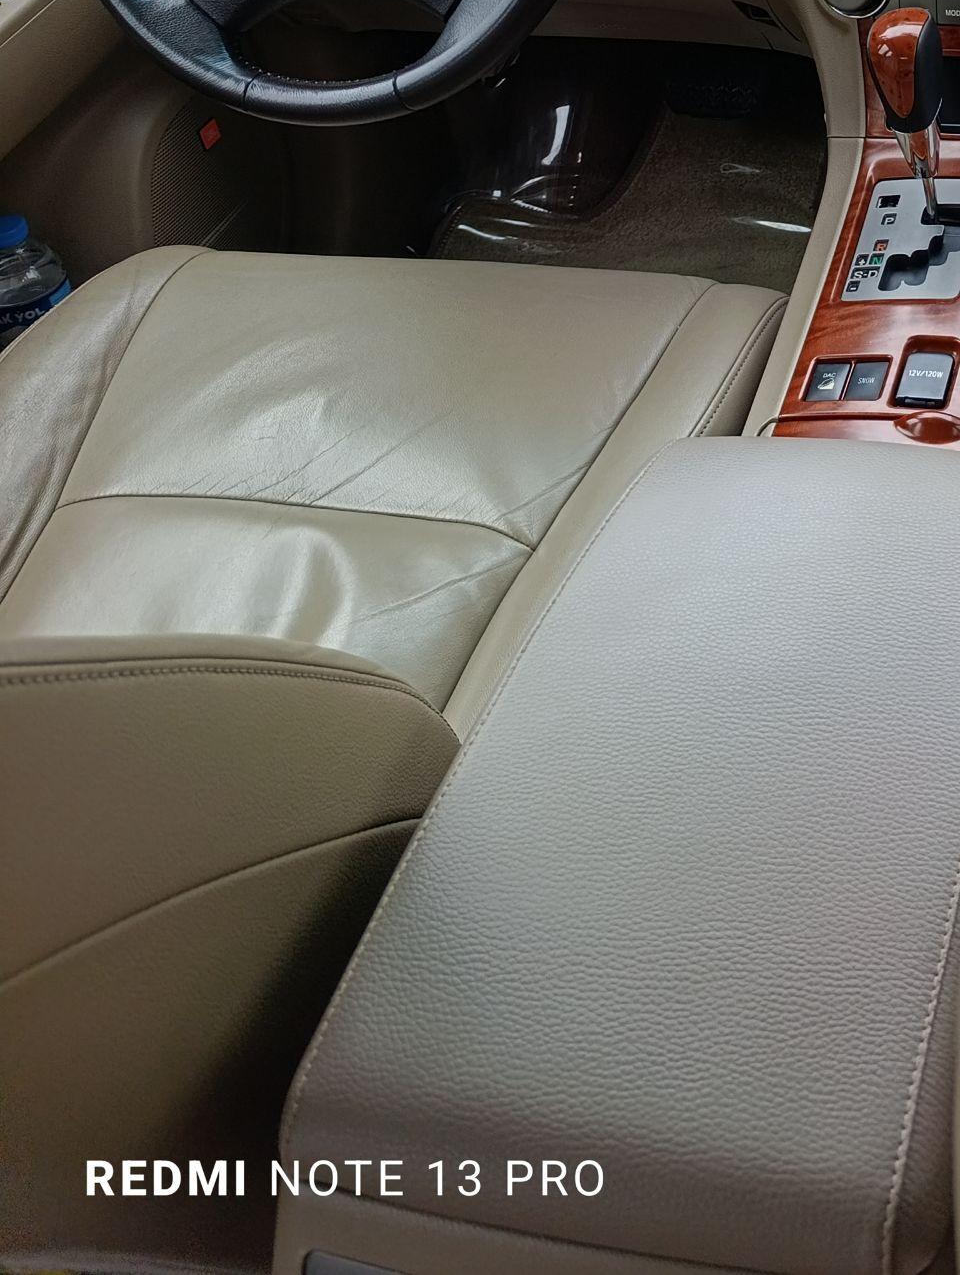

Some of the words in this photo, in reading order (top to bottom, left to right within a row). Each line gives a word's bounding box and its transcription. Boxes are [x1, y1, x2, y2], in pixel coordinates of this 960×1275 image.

[884, 217, 895, 225] P
[876, 243, 887, 251] R
[872, 256, 882, 265] N
[908, 369, 944, 378] 12V/120W
[857, 377, 876, 385] SNOW
